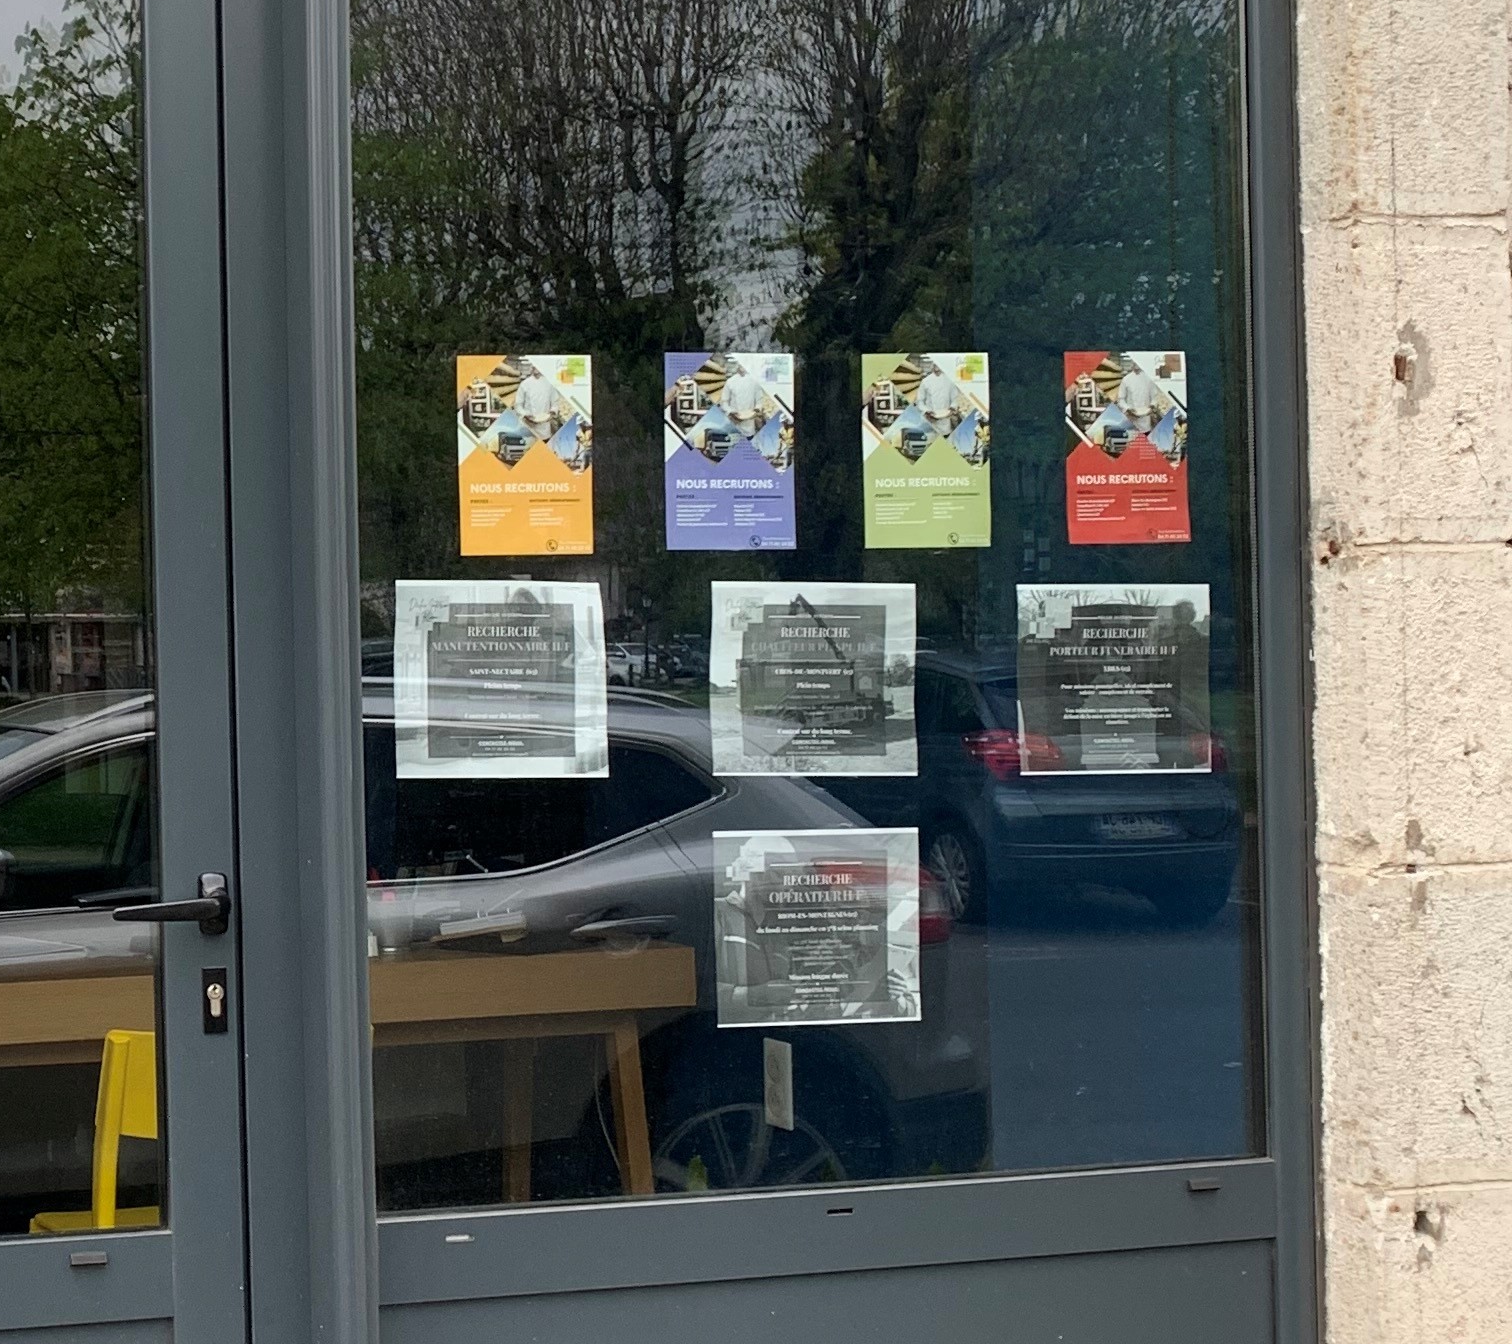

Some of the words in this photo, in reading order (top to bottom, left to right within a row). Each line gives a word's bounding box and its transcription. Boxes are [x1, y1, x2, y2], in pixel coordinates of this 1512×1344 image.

[676, 479, 708, 489] NOUS
[710, 479, 774, 489] RECRUTONS
[875, 478, 906, 488] NOUS
[908, 476, 970, 487] RECRUTONS
[1076, 475, 1106, 484] NOUS
[1109, 474, 1168, 484] RECRUTONS
[470, 483, 502, 494] NOUS
[505, 482, 570, 493] RECRUTONS
[467, 626, 540, 637] RECHERCHE
[780, 627, 850, 638] RECHERCHE
[1083, 628, 1148, 639] RECHERCHE
[432, 642, 548, 651] MANUTENTIONNAIRE
[1049, 647, 1098, 656] PORTEUR
[783, 873, 852, 886] RECHERCHE
[769, 889, 841, 904] OPÉRATEUR
